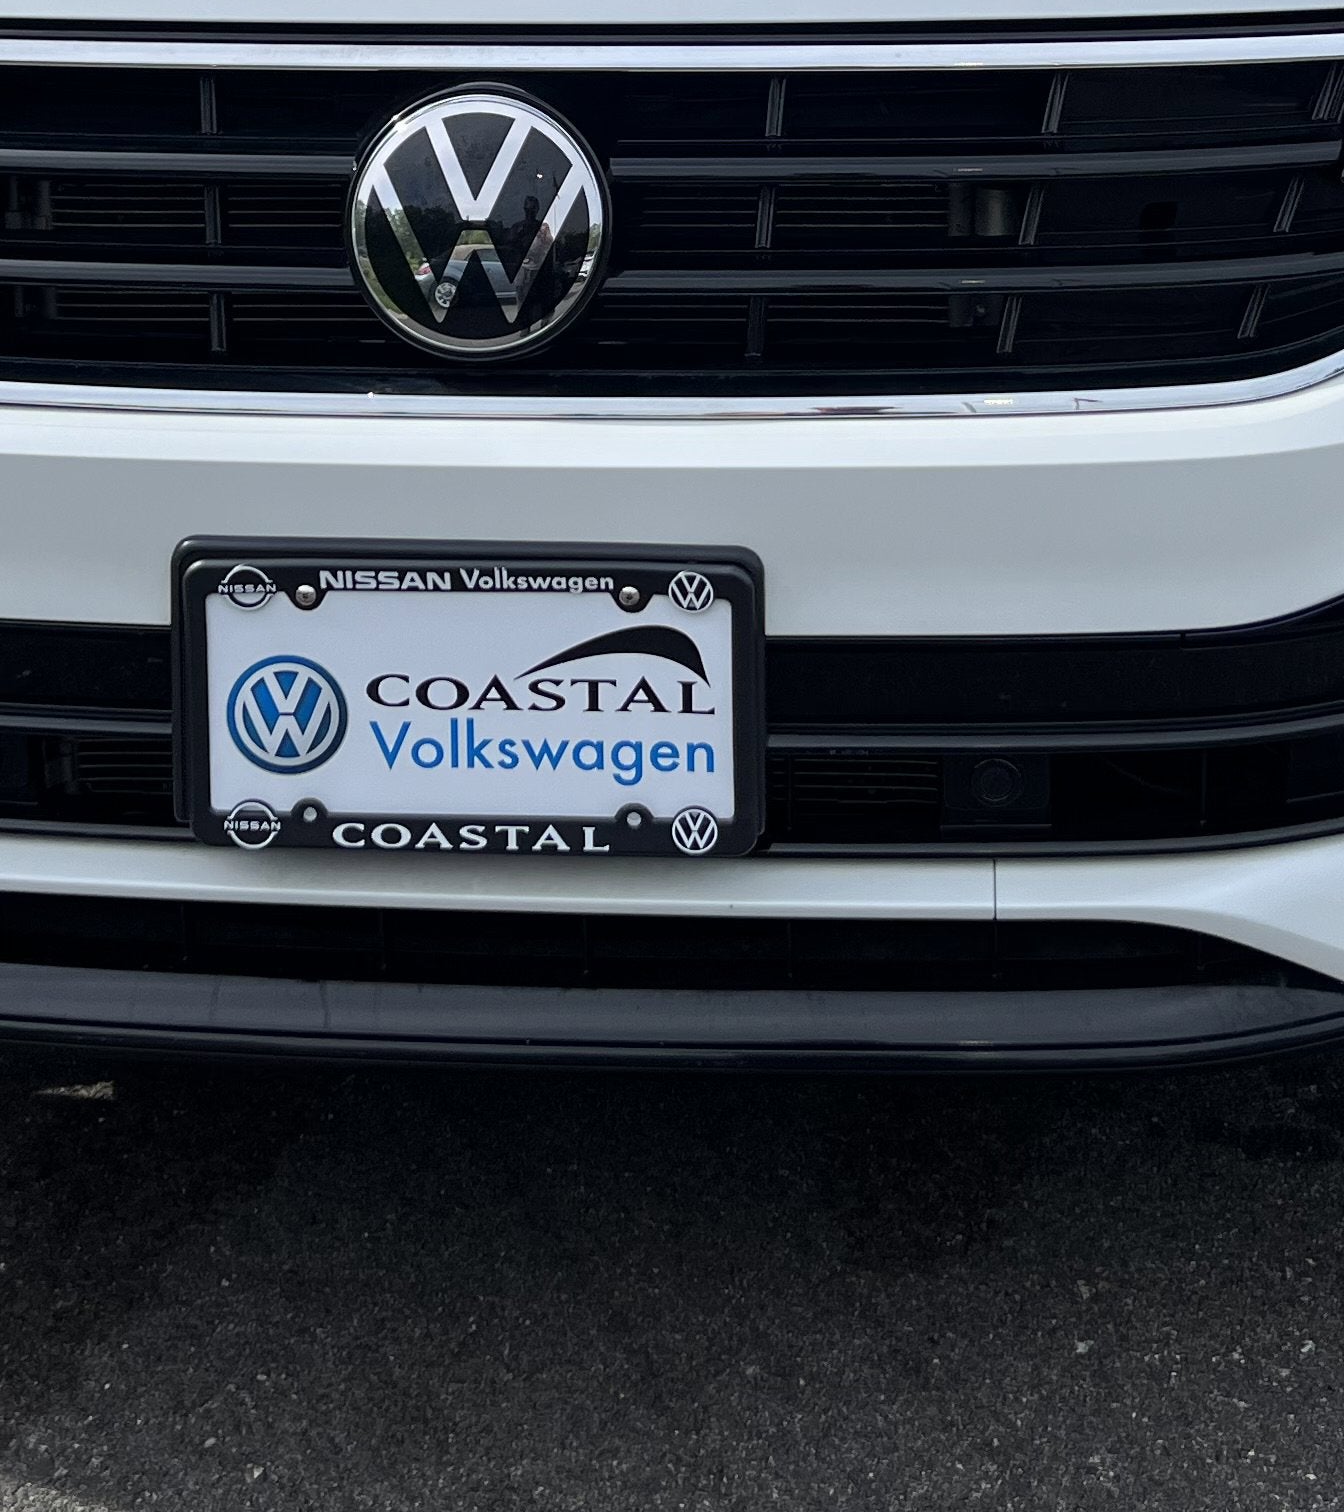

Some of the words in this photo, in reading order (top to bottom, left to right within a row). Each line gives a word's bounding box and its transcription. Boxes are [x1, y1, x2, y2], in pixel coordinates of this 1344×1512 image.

[218, 583, 276, 593] NISSAN
[319, 570, 452, 591] NISSAN
[459, 568, 614, 594] Volkswagen
[366, 675, 716, 714] COASTAL
[370, 718, 715, 786] Volkswagen
[223, 819, 281, 831] NISSAN
[332, 823, 609, 853] COASTAL
